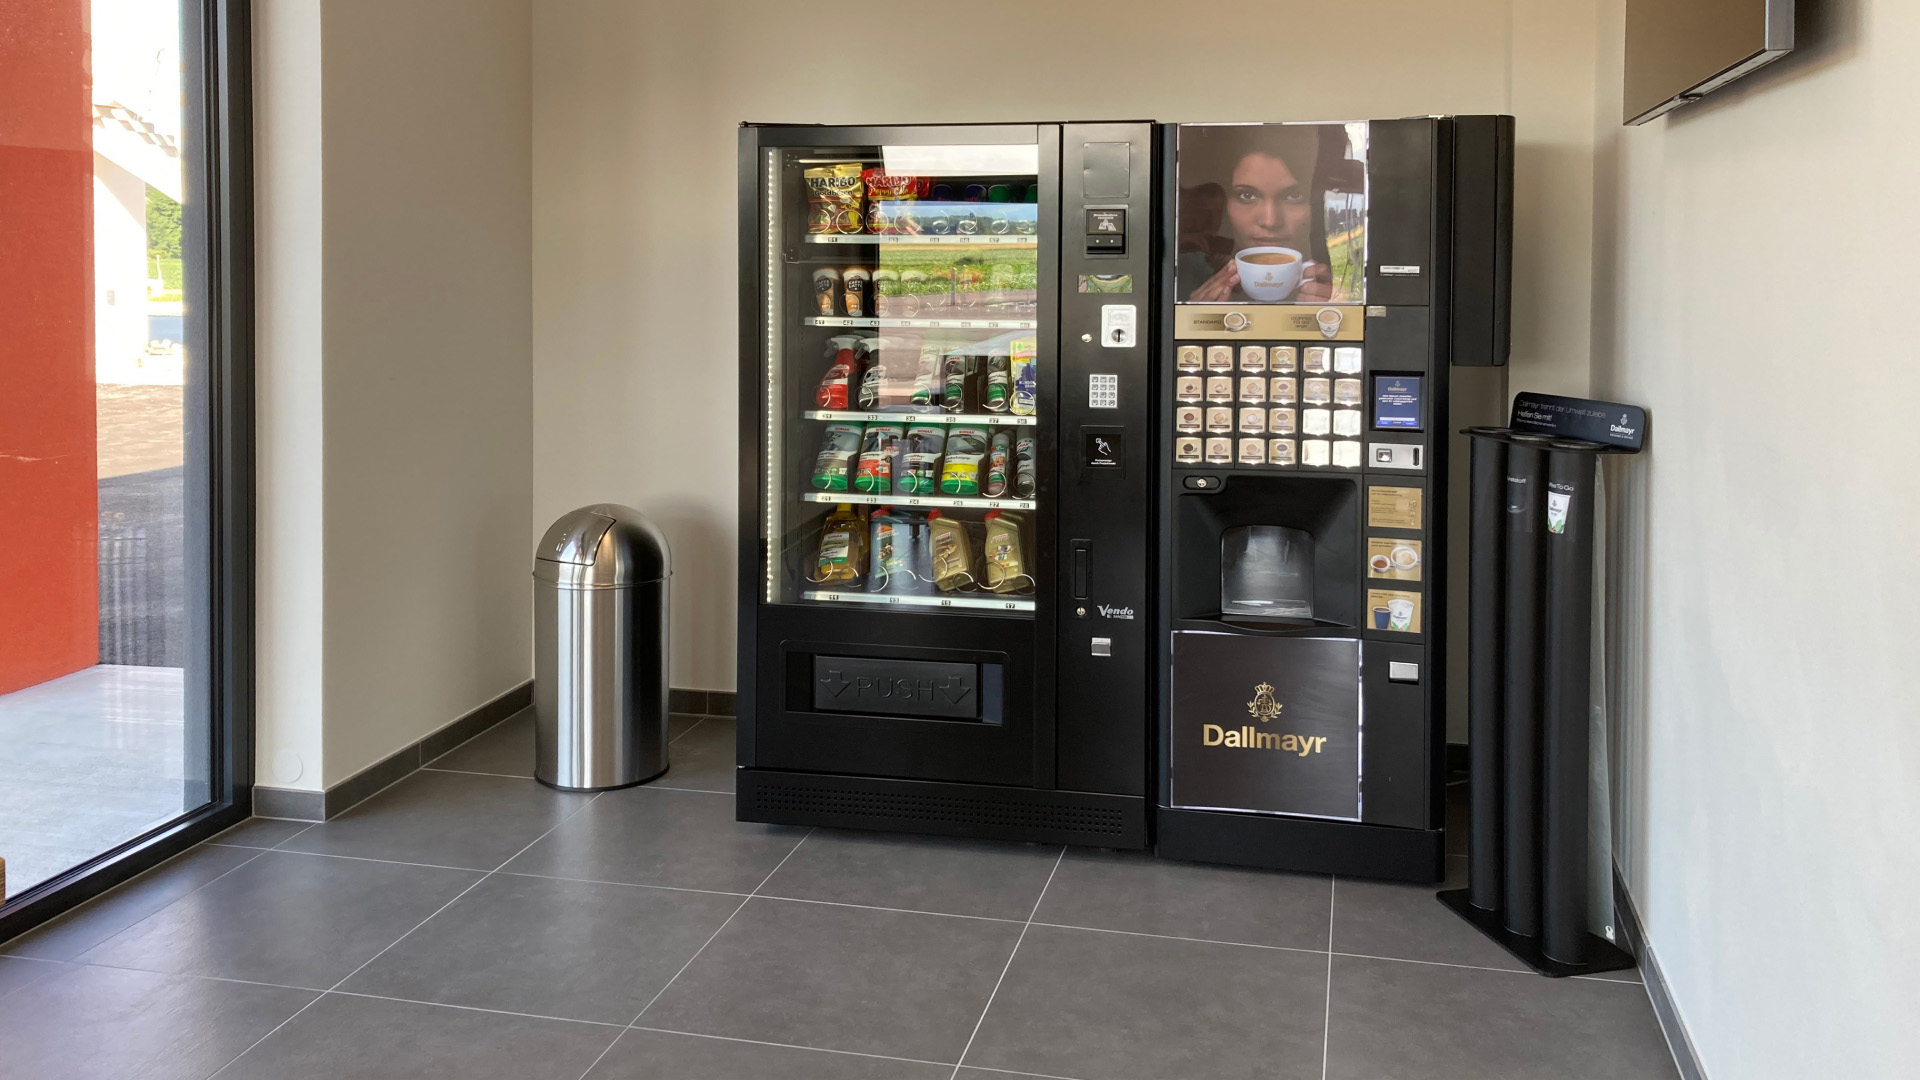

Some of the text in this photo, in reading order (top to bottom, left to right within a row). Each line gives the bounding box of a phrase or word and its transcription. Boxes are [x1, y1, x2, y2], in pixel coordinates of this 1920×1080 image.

[810, 177, 856, 188] HARIBO
[1517, 410, 1534, 418] Helfen
[1565, 407, 1586, 415] Umwelt
[1610, 425, 1635, 435] Dallmayr
[1097, 604, 1134, 616] Vendo
[856, 676, 934, 702] PUSH
[1203, 723, 1327, 758] Dallmayr
